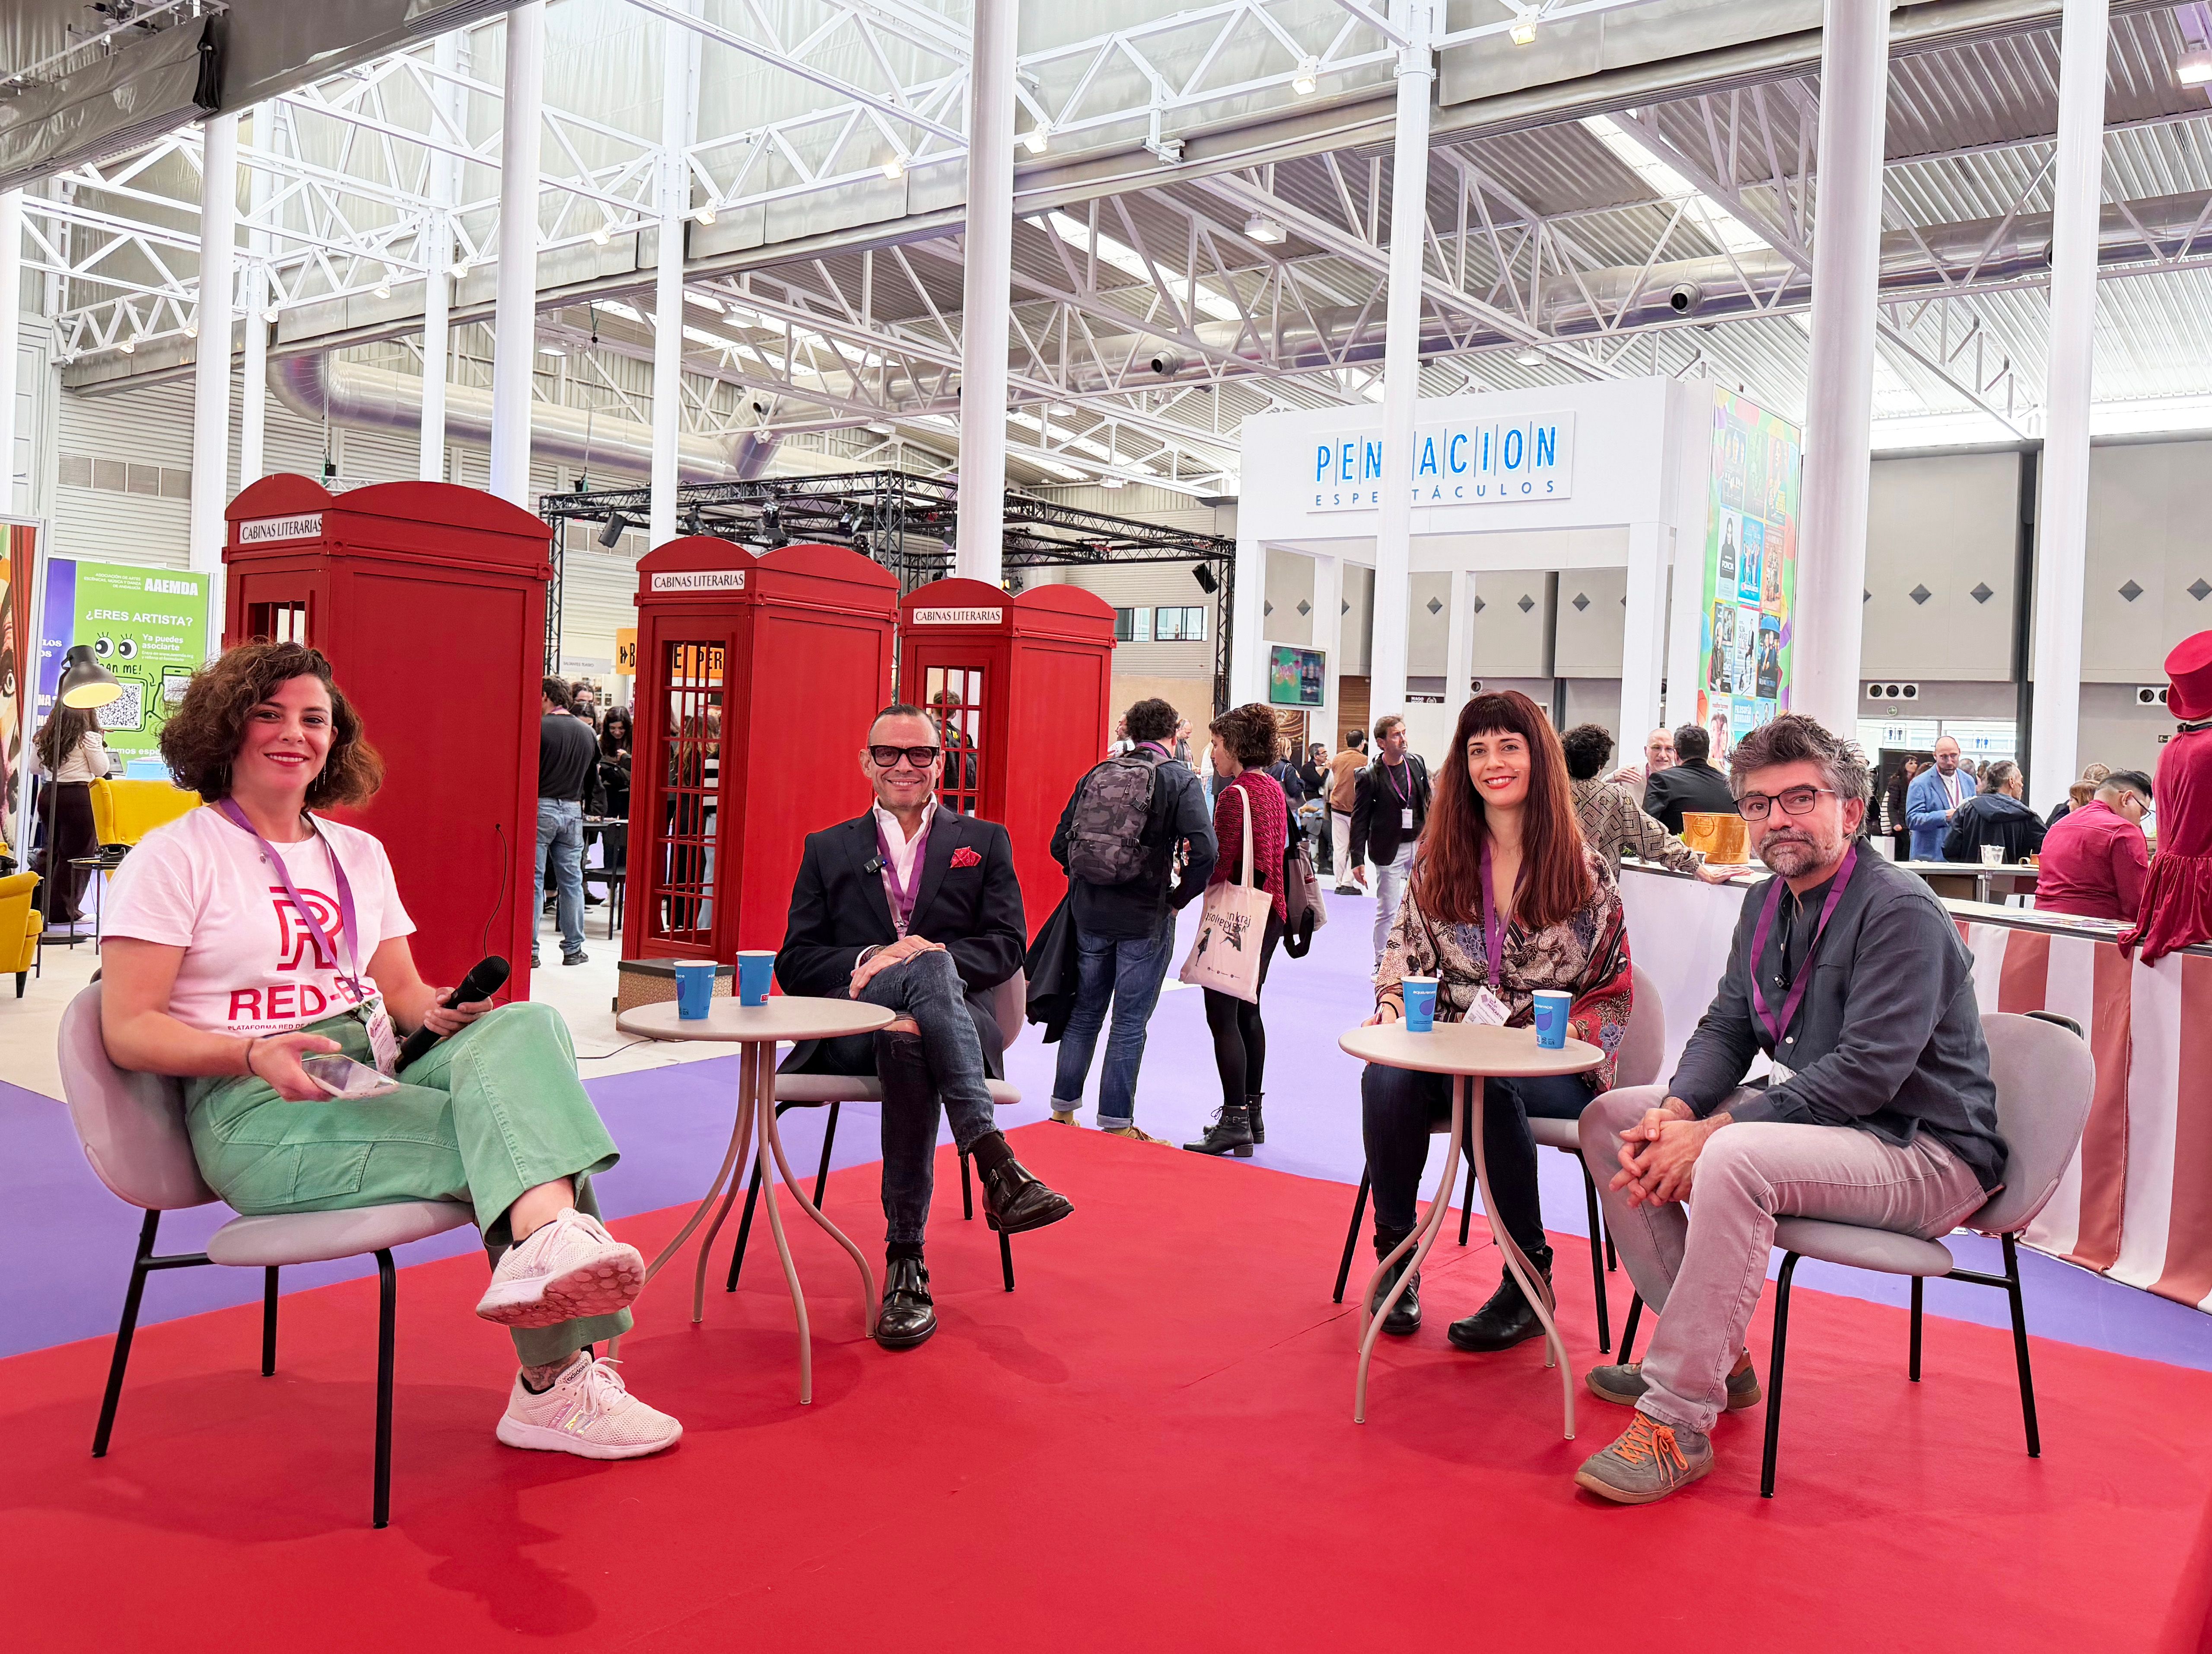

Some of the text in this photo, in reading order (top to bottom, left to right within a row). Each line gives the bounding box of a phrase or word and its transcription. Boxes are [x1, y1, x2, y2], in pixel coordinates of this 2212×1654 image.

[1316, 426, 1556, 482] PENACION
[1316, 480, 1553, 506] ESPETÁCULOS
[242, 518, 322, 540] CABINAS LITERARIAS
[144, 578, 198, 596] AAEMDA
[654, 574, 743, 588] CABINAS LITERARIAS
[86, 609, 194, 627] ¿ERES ARTISTA?
[916, 611, 1000, 621] CABINAS LITERARIAS
[142, 642, 180, 651] asociarte
[155, 635, 184, 644] puedes
[567, 1365, 585, 1381] adidas
